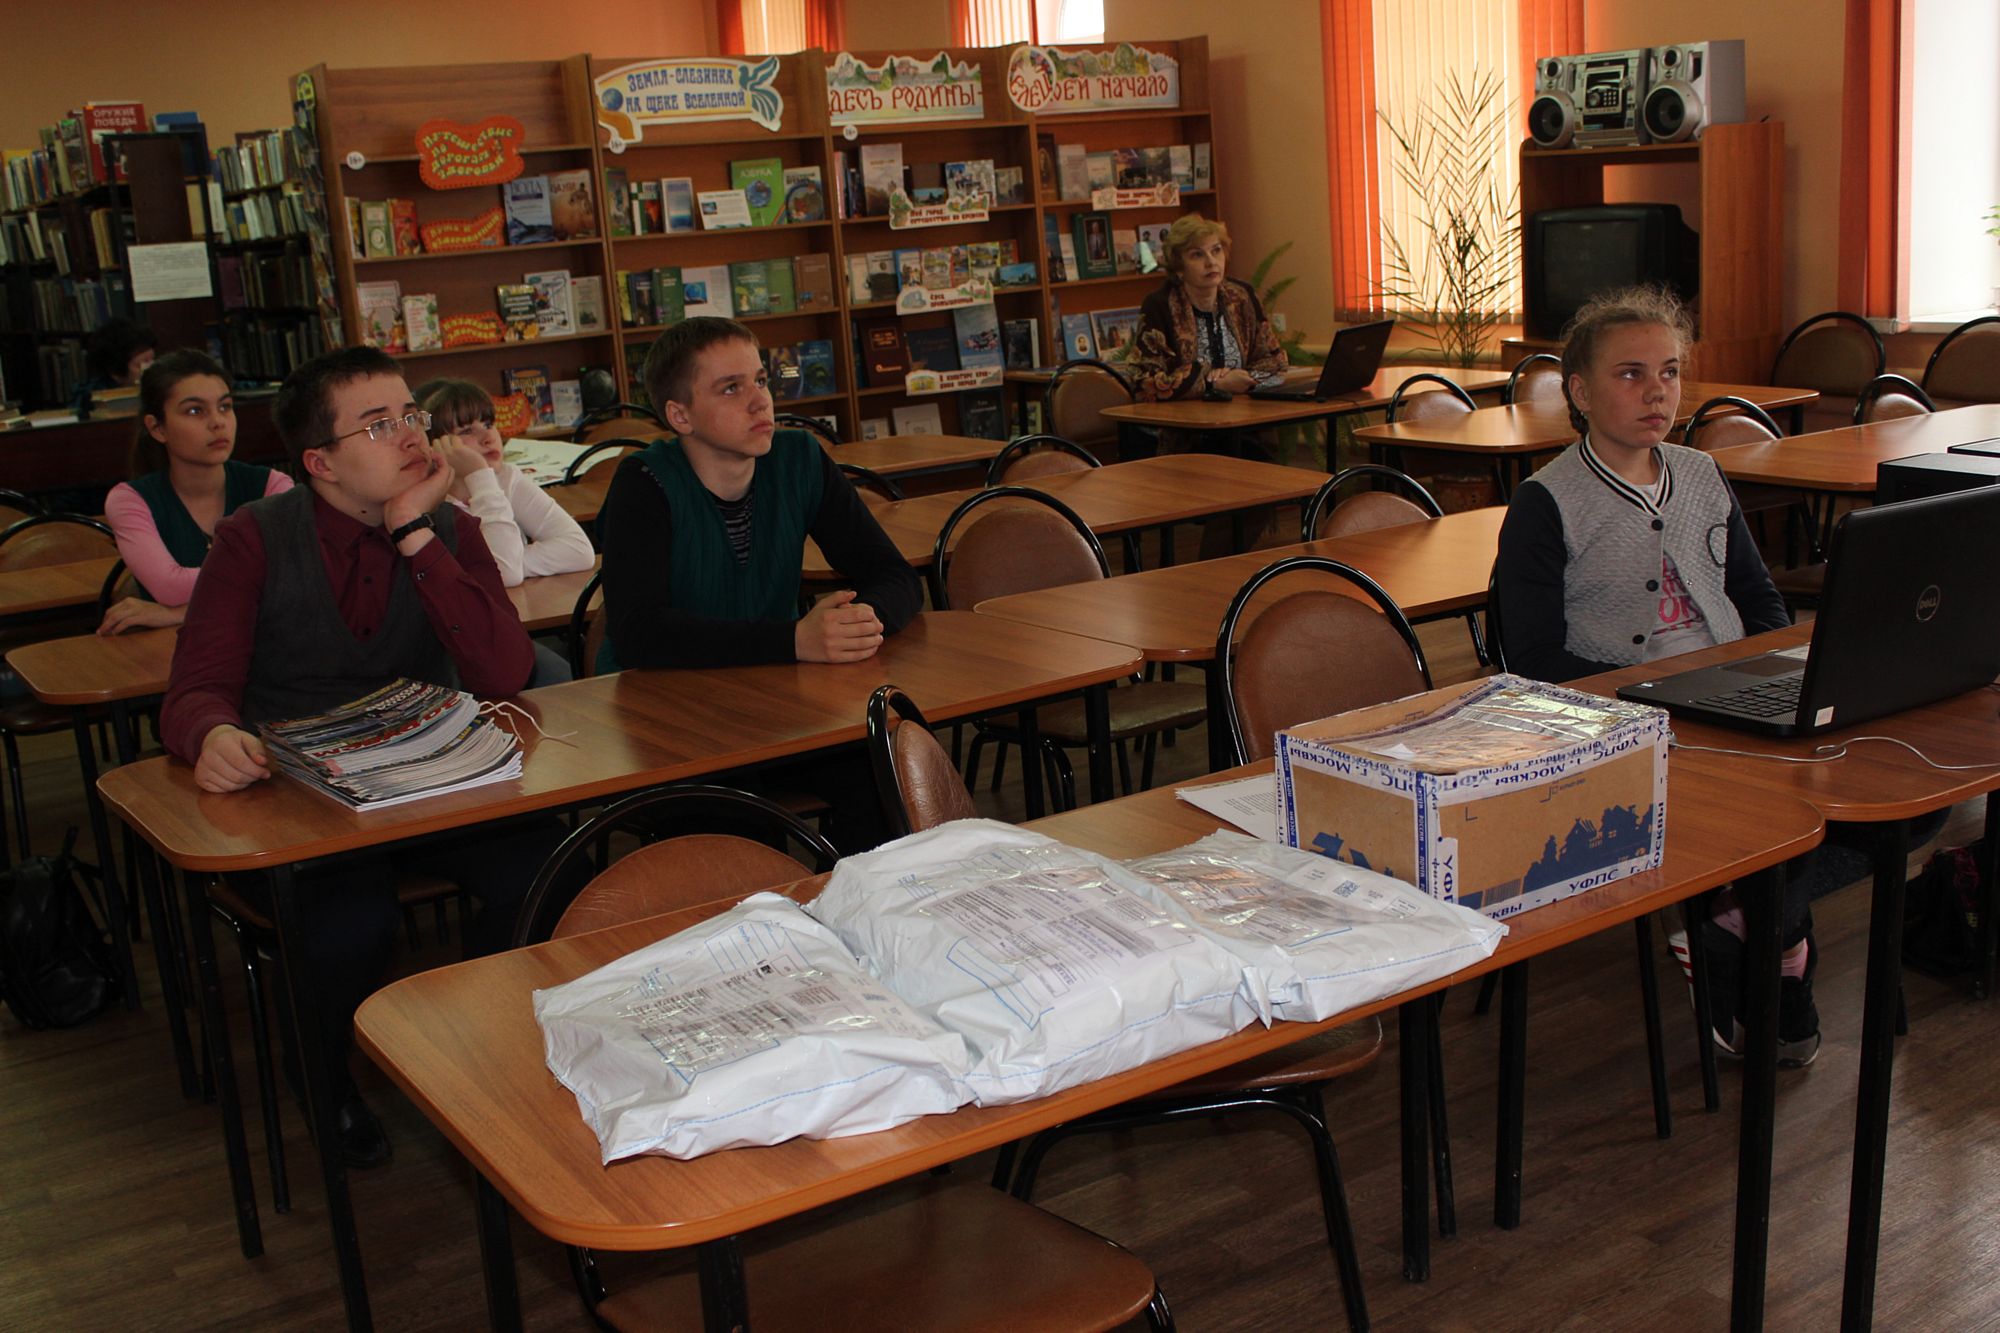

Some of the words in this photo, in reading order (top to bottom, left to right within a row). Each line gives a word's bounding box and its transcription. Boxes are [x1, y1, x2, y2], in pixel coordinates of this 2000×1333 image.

[627, 69, 668, 92] ЗЕМЛЯ
[676, 67, 734, 85] СЛЕЗИНКА
[1050, 75, 1090, 101] ОЕЙ
[626, 96, 642, 113] НА
[646, 94, 679, 113] ЩЕКЕ
[684, 88, 745, 109] ВСЕЛЕННОЙ
[892, 83, 976, 111] РОДИНЫ
[92, 108, 136, 118] ОРУЖИЕ
[94, 117, 138, 127] ПОБЕДЫ
[1918, 596, 1938, 611] DELL
[1290, 747, 1351, 774] Москвы
[1495, 760, 1566, 786] Москвы
[1569, 868, 1619, 893] УФПС
